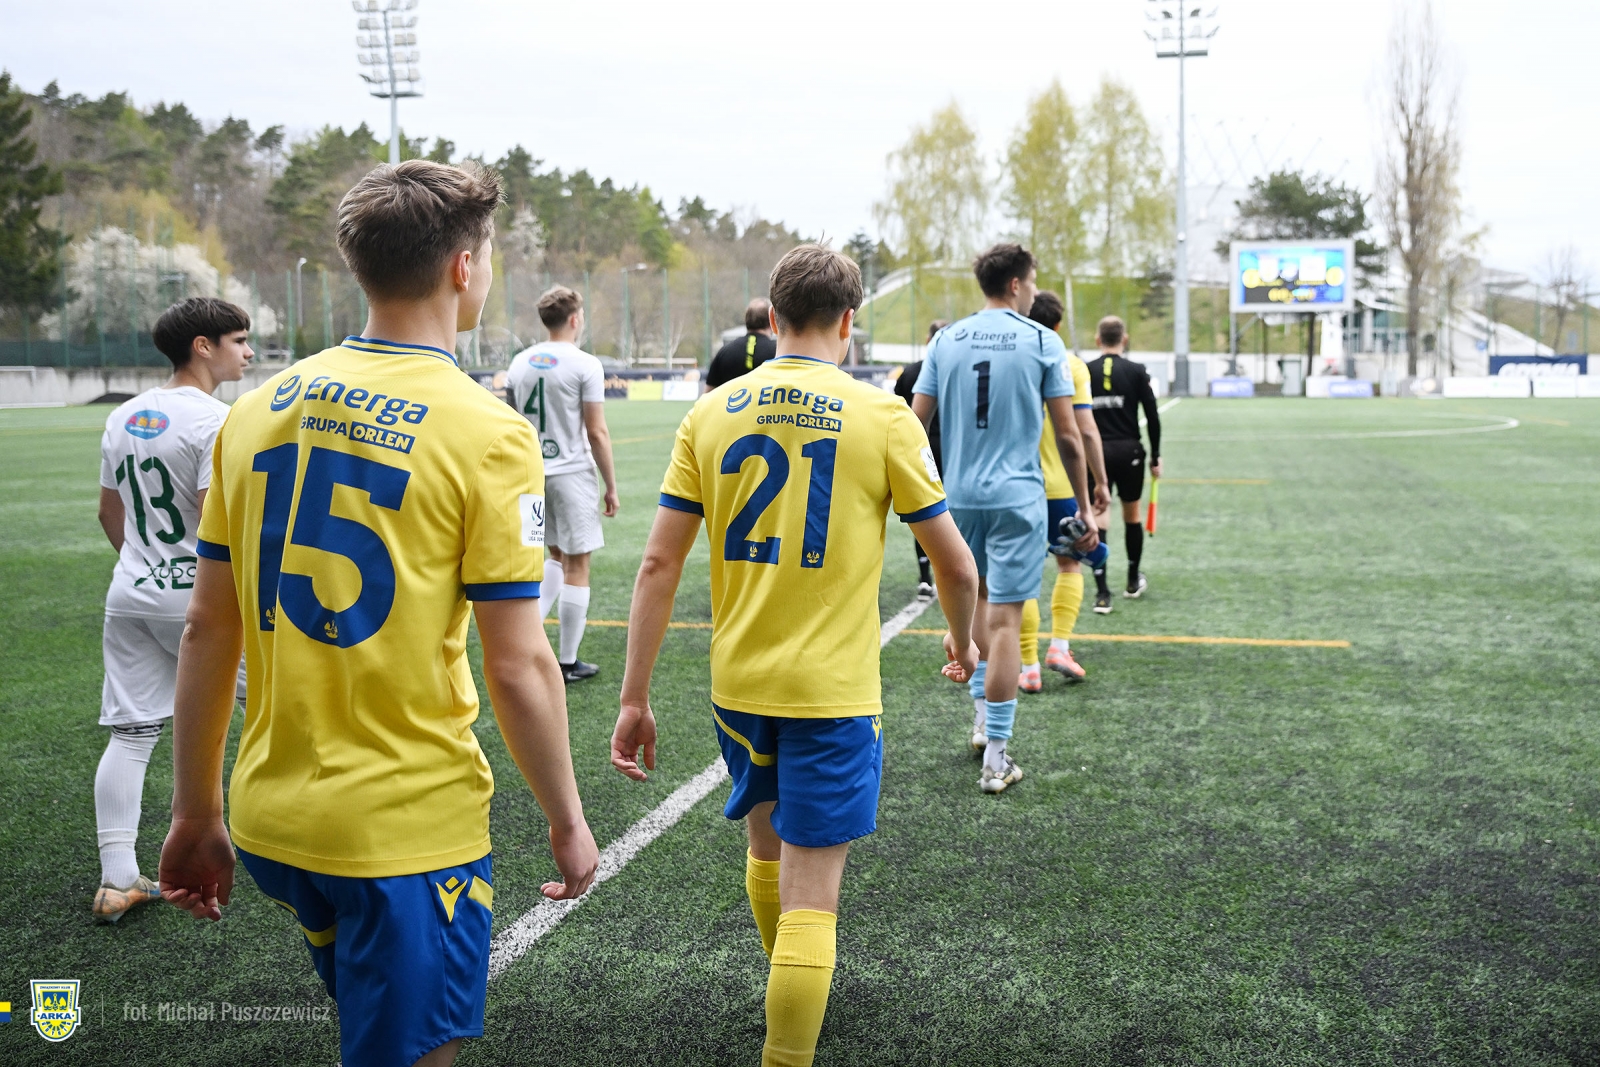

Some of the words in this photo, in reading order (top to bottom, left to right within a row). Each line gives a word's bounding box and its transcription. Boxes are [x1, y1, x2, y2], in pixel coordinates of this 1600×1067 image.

[972, 331, 1017, 344] Energa
[304, 375, 429, 426] Energa
[523, 376, 546, 433] 4
[758, 385, 844, 415] Energa
[972, 360, 991, 429] 1
[301, 416, 348, 437] GRUPA
[351, 422, 413, 452] ORLEN
[757, 414, 795, 425] GRUPA
[797, 414, 840, 431] ORLEN
[115, 454, 187, 547] 13
[720, 433, 838, 569] 21
[252, 441, 411, 649] 15
